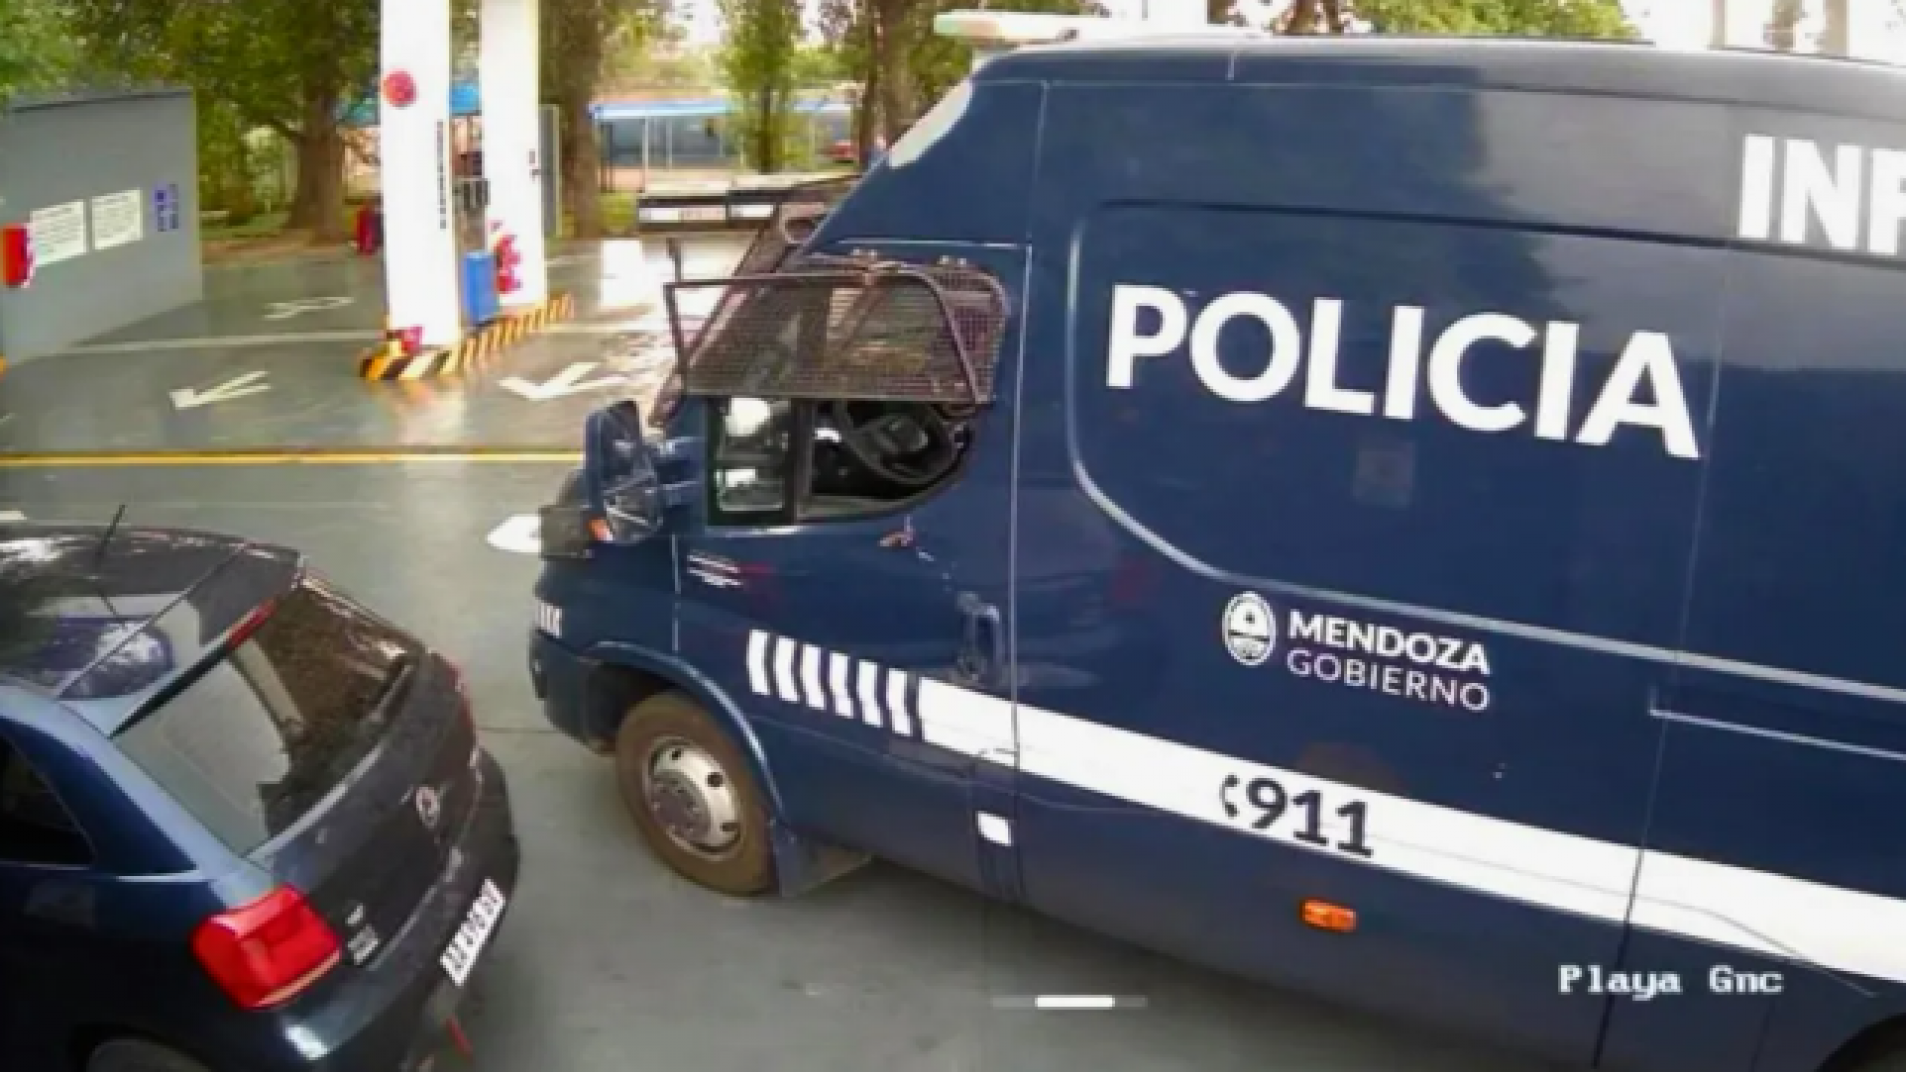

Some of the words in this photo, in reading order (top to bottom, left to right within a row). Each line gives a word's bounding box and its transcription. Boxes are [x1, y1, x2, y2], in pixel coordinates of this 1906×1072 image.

[1106, 284, 1699, 459] POLICIA
[1288, 609, 1490, 675] MENDOZA
[1287, 647, 1490, 711] GOBIERNO
[1246, 777, 1373, 858] 911
